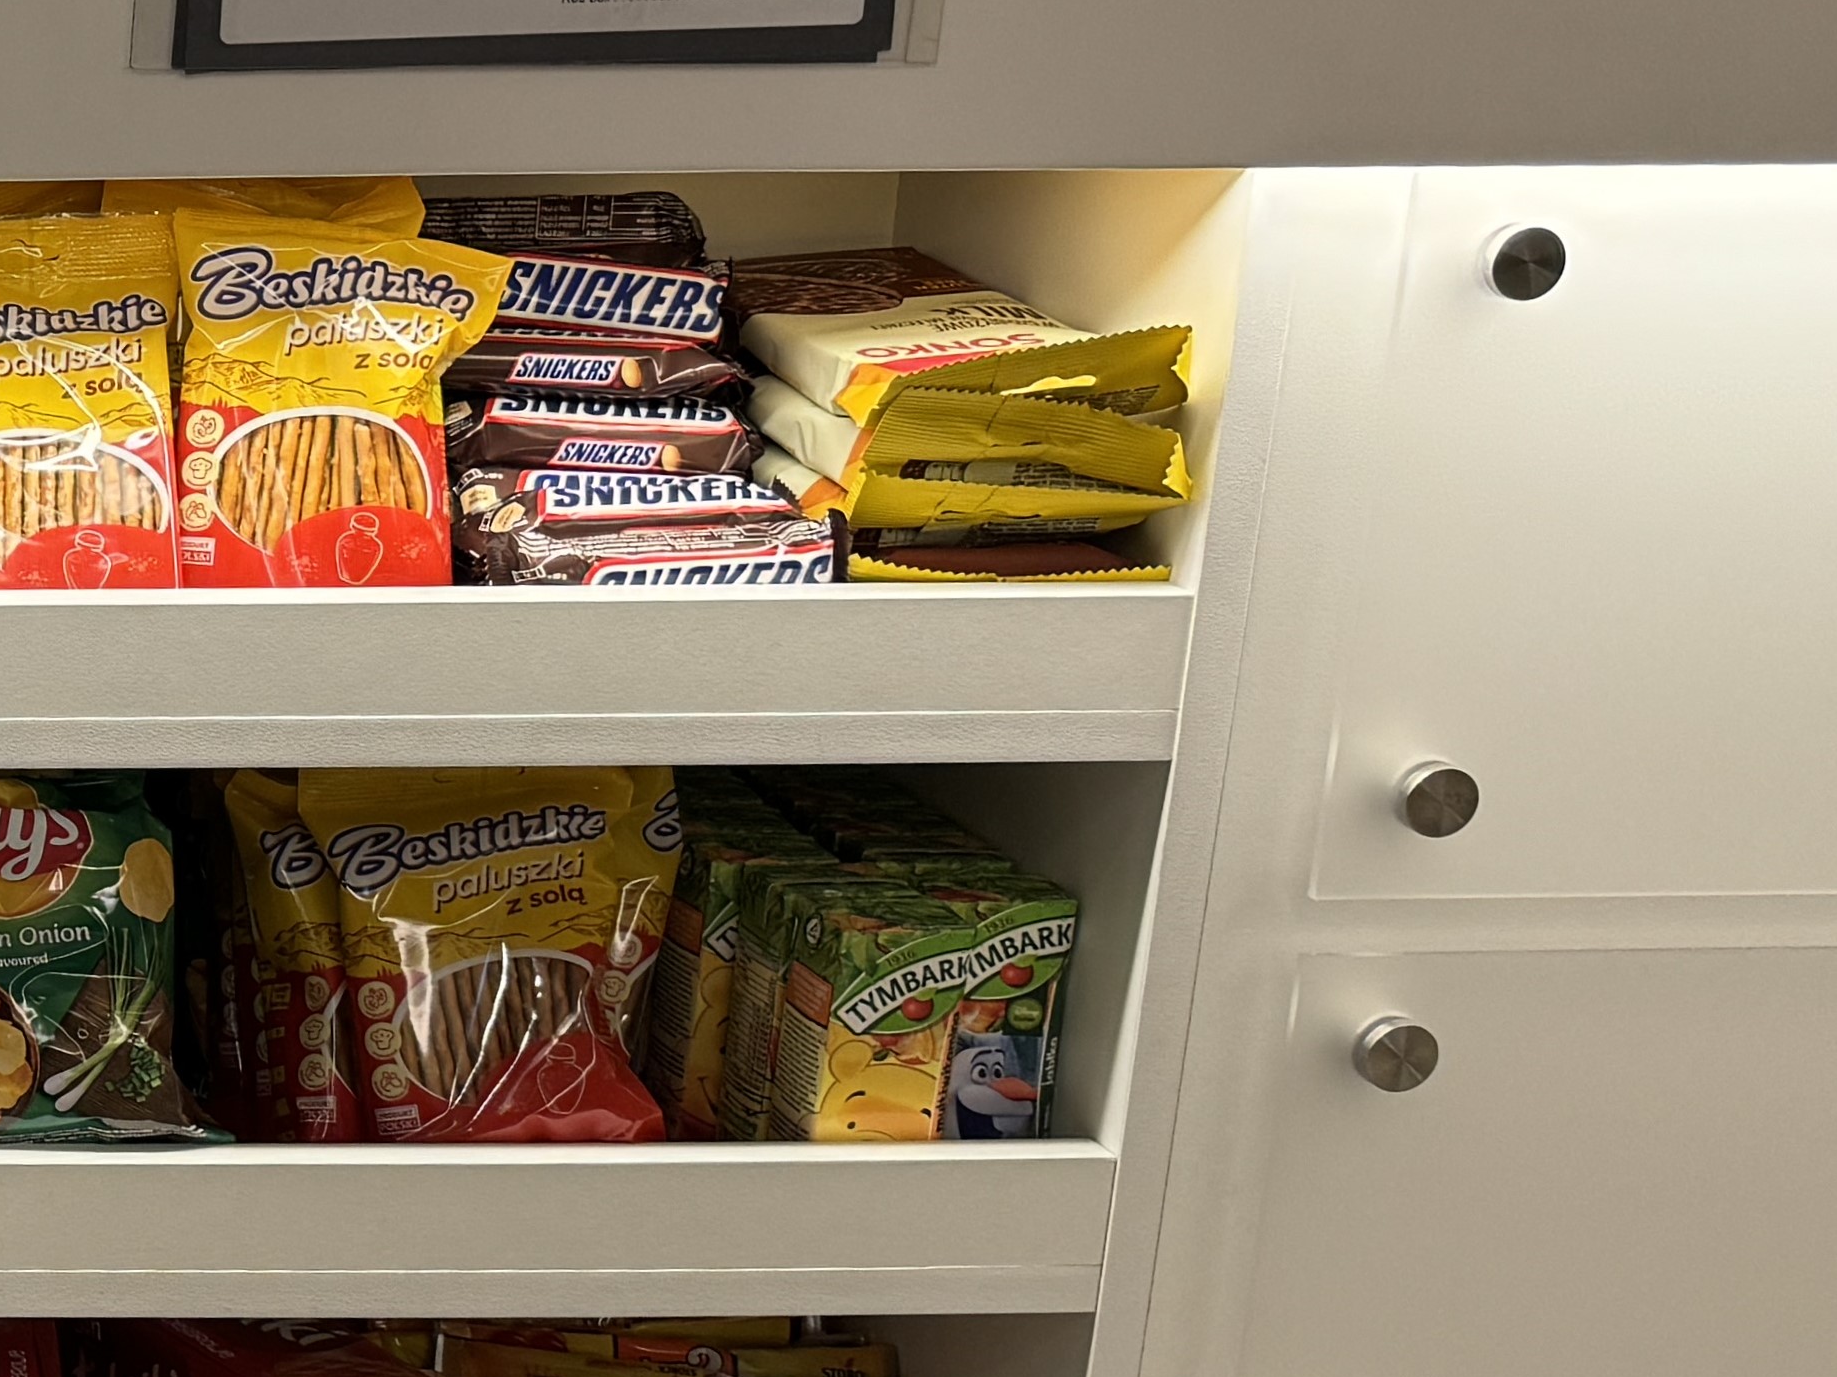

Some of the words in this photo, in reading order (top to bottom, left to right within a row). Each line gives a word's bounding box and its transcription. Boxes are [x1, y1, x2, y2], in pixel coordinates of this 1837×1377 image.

[191, 245, 475, 322] Beskidzkie
[498, 260, 727, 333] SNICKERS
[282, 310, 446, 357] paluszki
[516, 355, 617, 382] SNICKERS
[558, 441, 656, 466] SNICKERS
[328, 802, 608, 895] Beskidzkie
[431, 849, 587, 915] paluszki
[529, 882, 589, 912] solą
[17, 921, 92, 948] Onion
